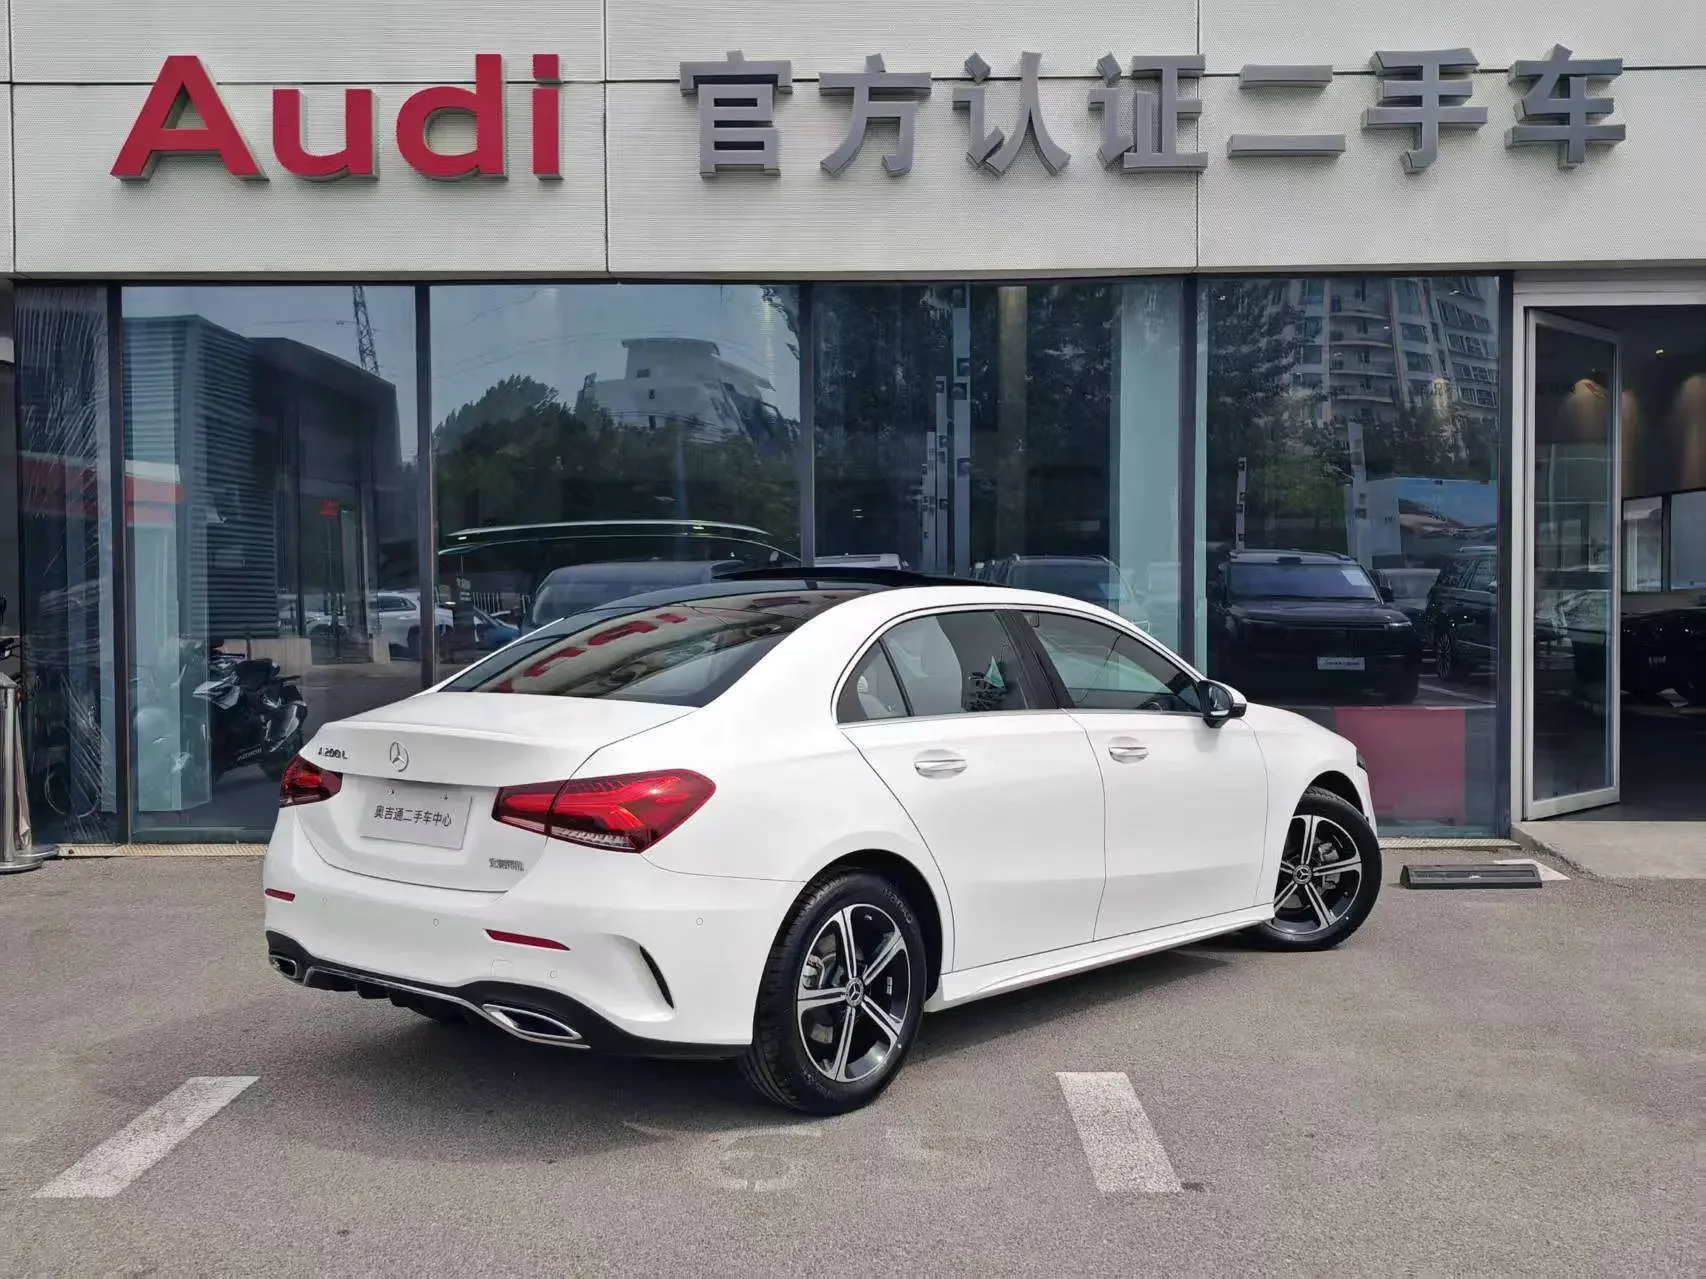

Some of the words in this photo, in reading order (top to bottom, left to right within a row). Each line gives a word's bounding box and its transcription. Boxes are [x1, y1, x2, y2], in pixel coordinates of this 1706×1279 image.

[110, 53, 564, 181] Audi
[680, 44, 1626, 175] 官方认证二手车
[374, 804, 452, 827] 奥吉通二手车中心
